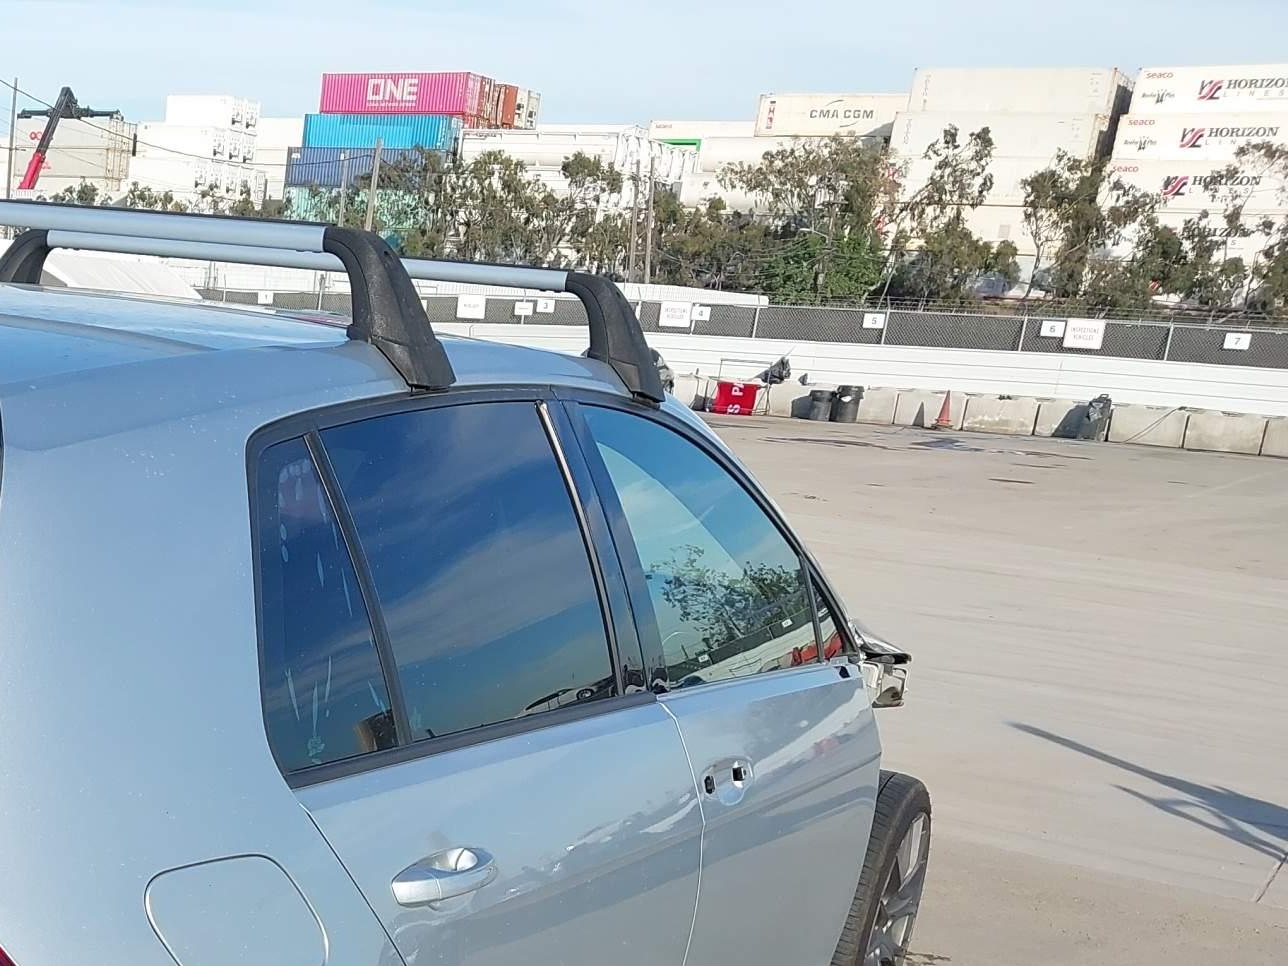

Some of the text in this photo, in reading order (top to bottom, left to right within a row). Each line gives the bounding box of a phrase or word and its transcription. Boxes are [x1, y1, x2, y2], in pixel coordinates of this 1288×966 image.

[367, 78, 418, 101] ONE
[1227, 78, 1288, 90] HORIZO
[809, 109, 874, 120] CMA CGM
[1208, 126, 1280, 138] HORIZON
[1049, 325, 1056, 333] 6
[1234, 337, 1241, 345] 7
